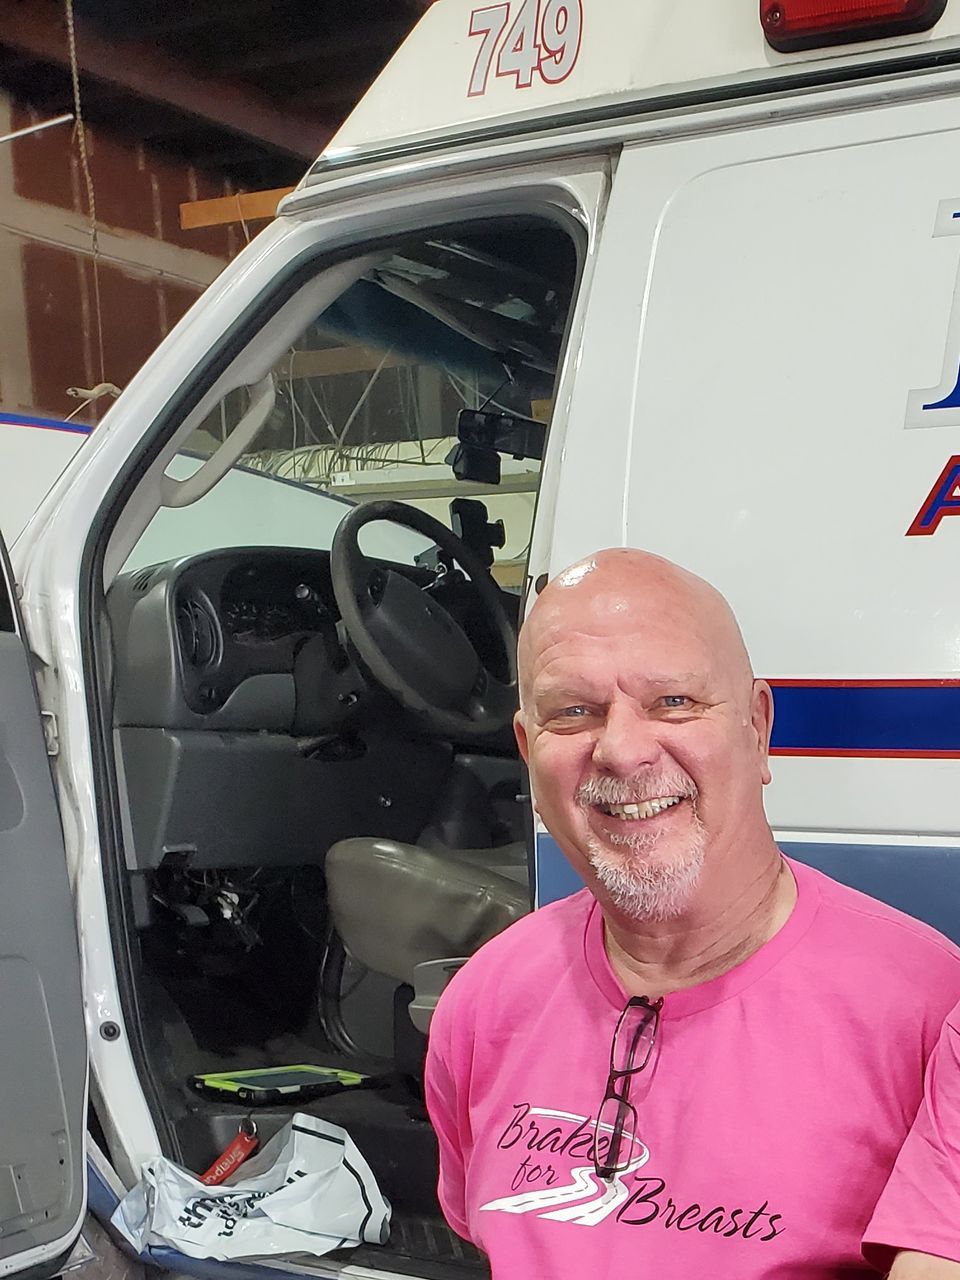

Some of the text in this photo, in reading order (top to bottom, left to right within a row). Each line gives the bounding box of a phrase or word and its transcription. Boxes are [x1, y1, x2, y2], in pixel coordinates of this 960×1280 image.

[467, 0, 583, 97] 749
[497, 1103, 623, 1162] Brake
[511, 1155, 560, 1191] for
[616, 1177, 787, 1242] Breasts
